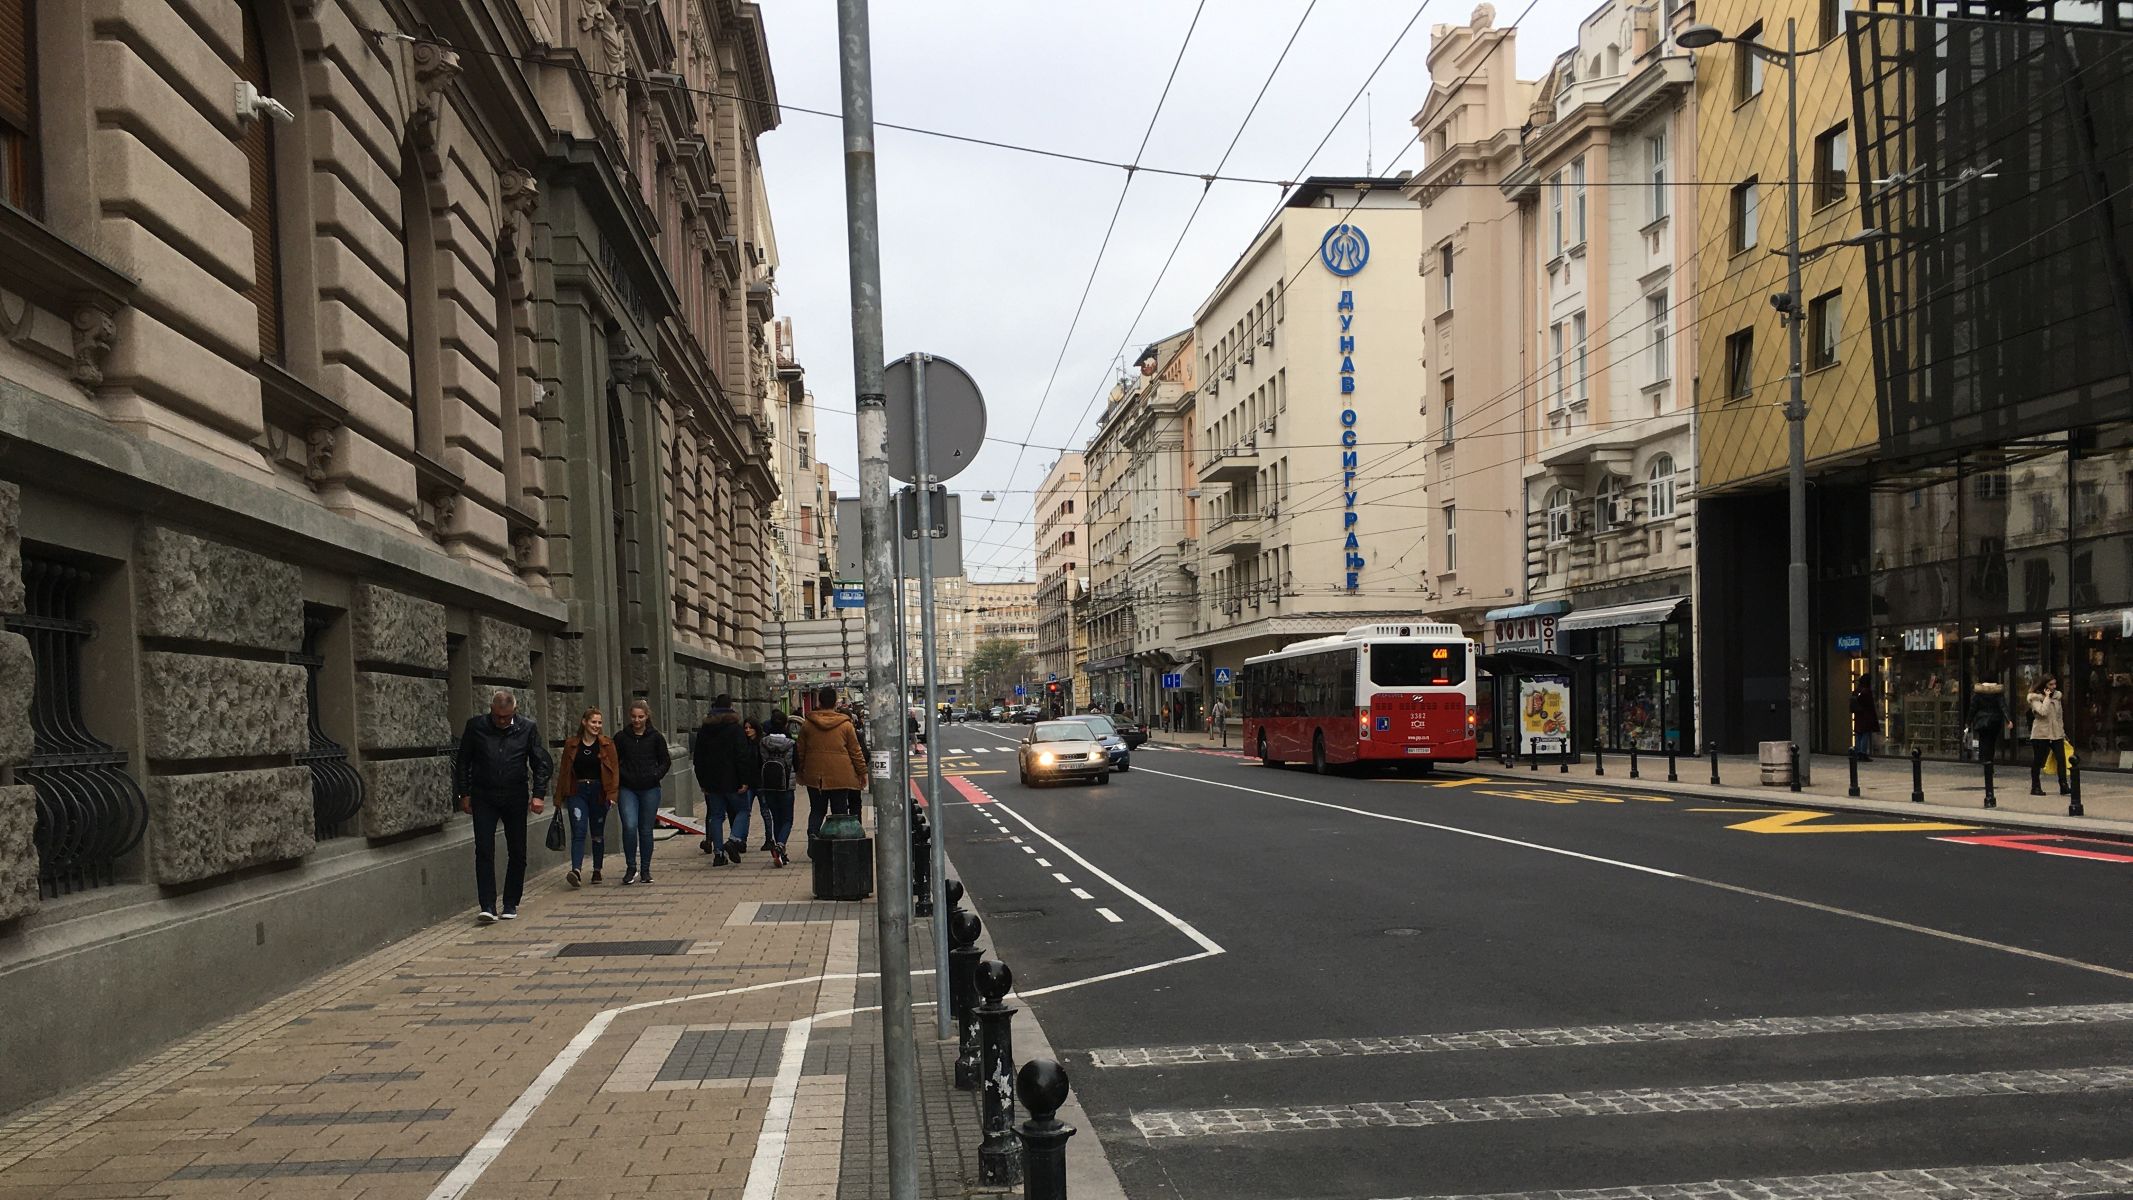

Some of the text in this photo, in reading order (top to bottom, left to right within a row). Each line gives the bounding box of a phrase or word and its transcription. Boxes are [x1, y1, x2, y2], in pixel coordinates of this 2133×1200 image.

[1337, 290, 1365, 590] ДУНАВ ОСИГУРАЊЕ
[1838, 636, 1860, 648] Knjižara
[1904, 627, 1939, 651] DELFI
